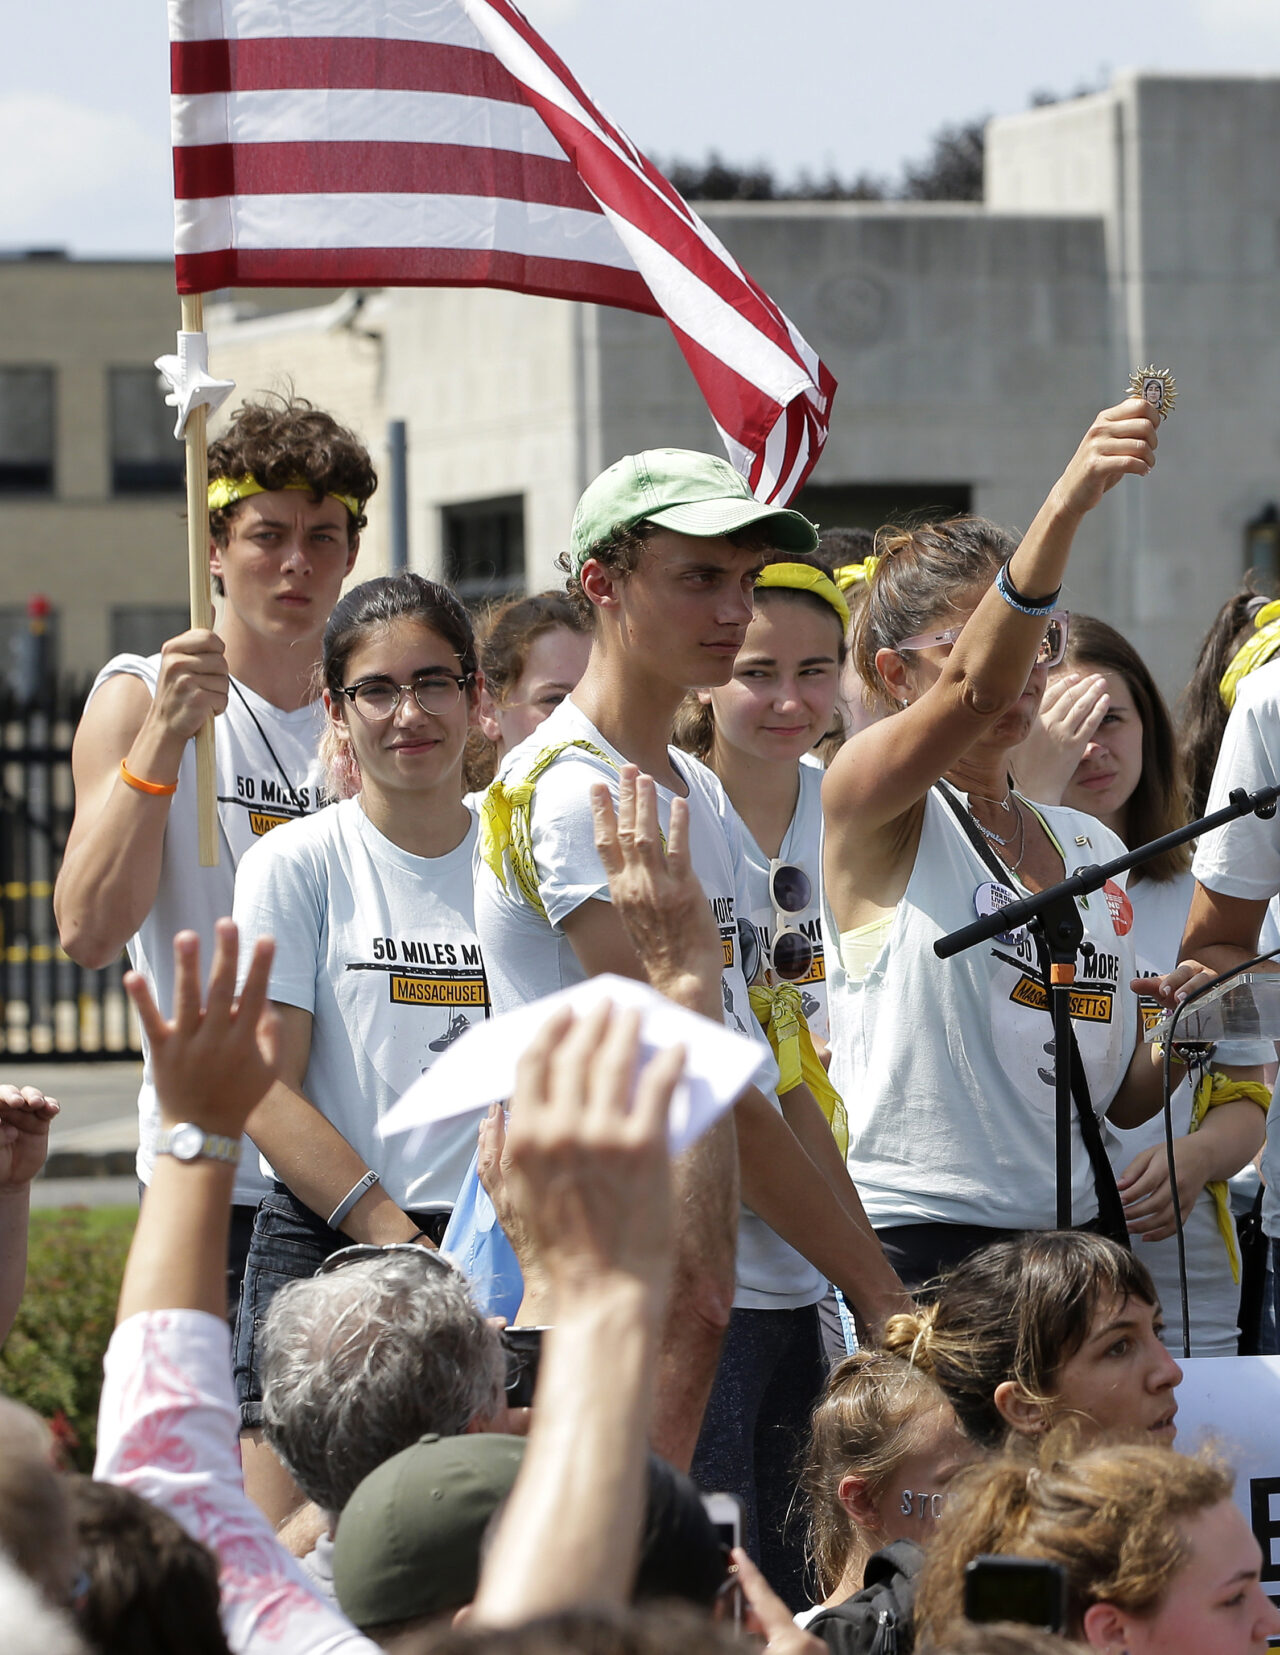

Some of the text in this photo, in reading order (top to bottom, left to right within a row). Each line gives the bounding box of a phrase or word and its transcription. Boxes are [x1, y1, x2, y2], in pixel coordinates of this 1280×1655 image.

[236, 775, 256, 799] 50
[991, 884, 1012, 896] MARC
[372, 937, 397, 961] 50
[401, 940, 458, 965] MILES
[1083, 953, 1119, 981] MORE
[397, 979, 485, 1002] MASSACHUSET
